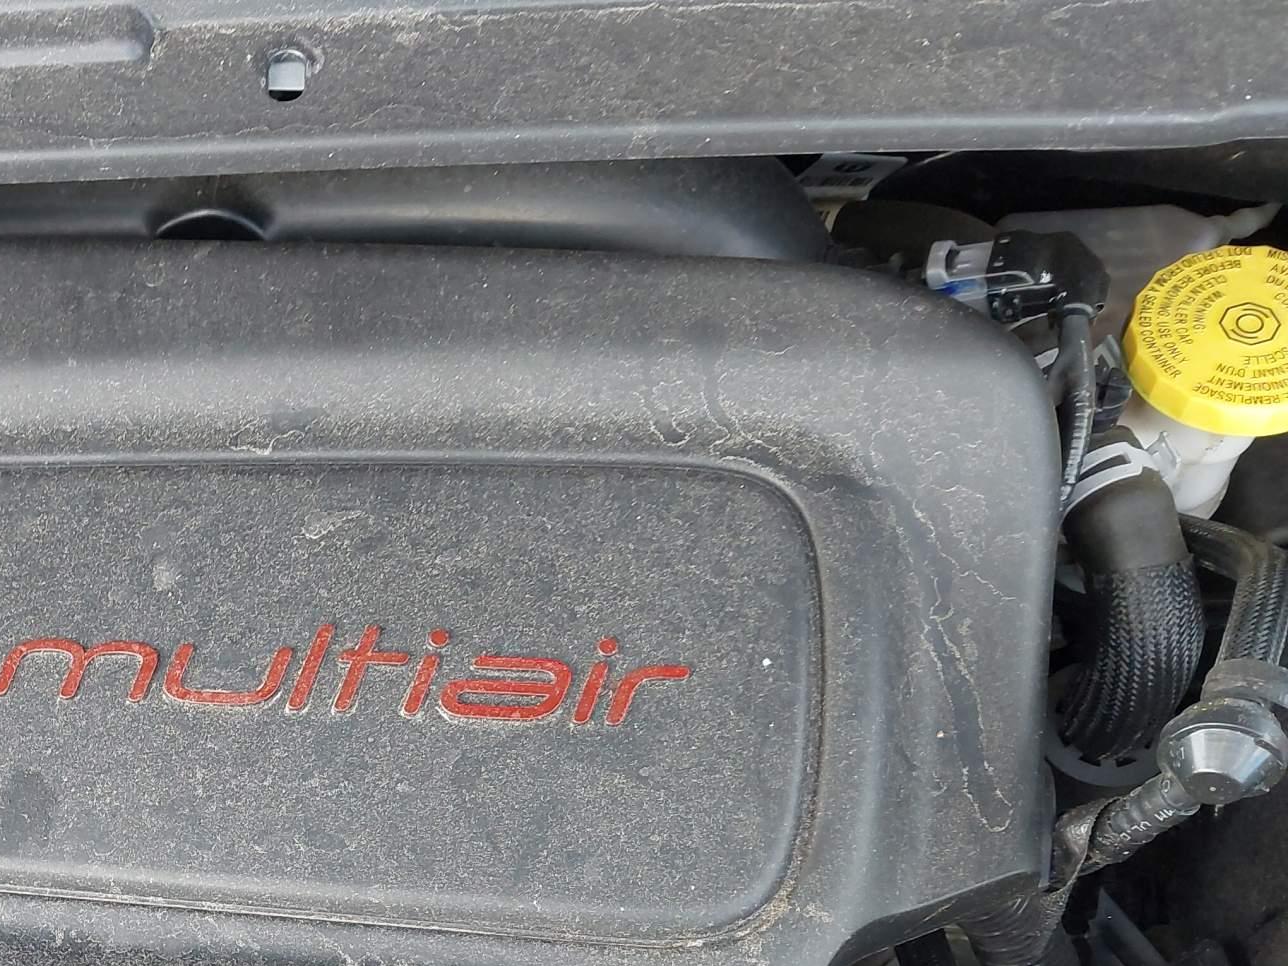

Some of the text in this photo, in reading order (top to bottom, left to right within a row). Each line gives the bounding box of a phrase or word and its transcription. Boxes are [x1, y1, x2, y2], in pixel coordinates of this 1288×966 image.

[1228, 246, 1252, 258] DOT
[1154, 264, 1184, 288] FROM
[1196, 258, 1242, 277] BEFORE
[1138, 294, 1158, 329] SEALED
[1174, 274, 1228, 346] CLEAN FILLER CAP
[1156, 321, 1172, 339] USE
[1140, 328, 1182, 379] CONTAINER
[1165, 341, 1190, 364] ONLY
[1216, 363, 1246, 378] D'UN
[1192, 382, 1281, 405] REMPLISSAGE
